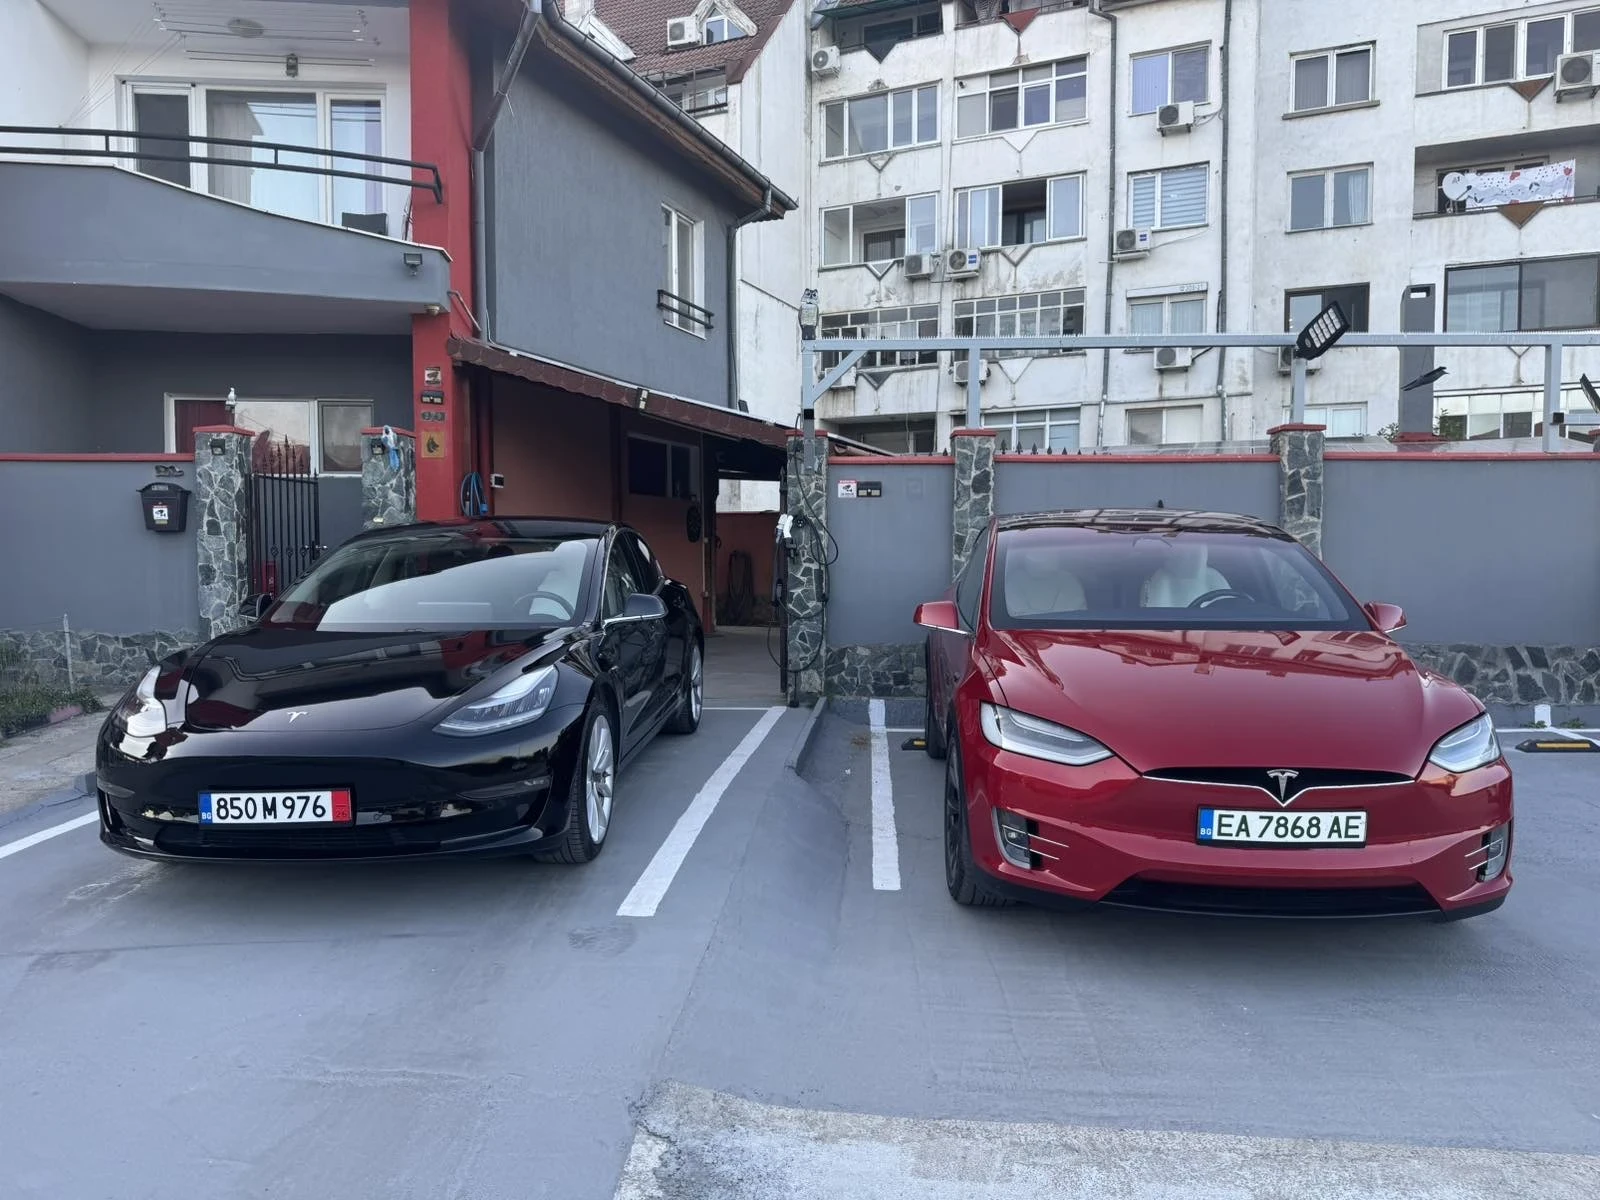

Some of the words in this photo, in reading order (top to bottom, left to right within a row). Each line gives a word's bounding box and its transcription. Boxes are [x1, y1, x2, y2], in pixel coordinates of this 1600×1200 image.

[201, 812, 212, 820] BG
[216, 796, 257, 820] 850
[262, 796, 278, 819] M
[282, 795, 326, 819] 976
[1200, 828, 1212, 836] BG
[1217, 814, 1251, 838] EA
[1258, 815, 1321, 838] 7868
[1327, 815, 1362, 839] AE
